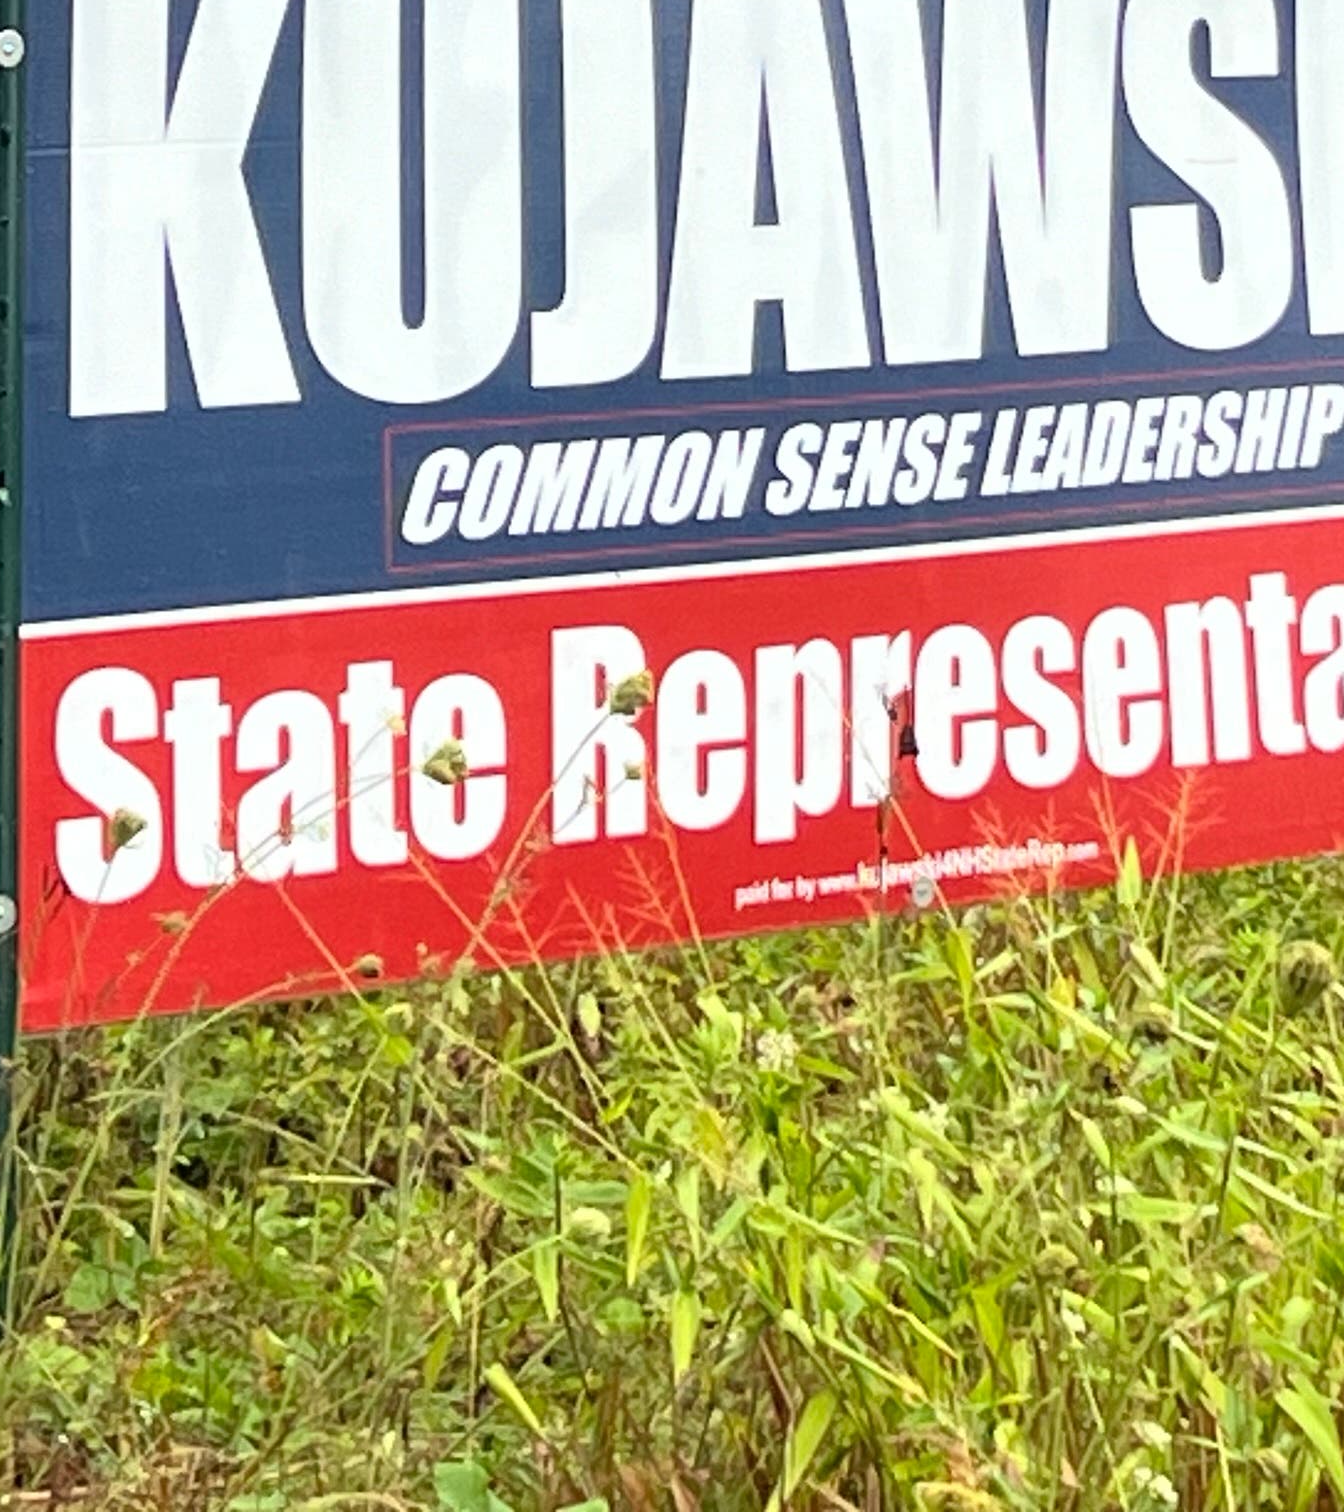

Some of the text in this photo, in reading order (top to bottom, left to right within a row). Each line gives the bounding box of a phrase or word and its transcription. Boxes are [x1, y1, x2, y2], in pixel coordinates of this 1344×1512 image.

[400, 426, 763, 545] COMMON
[763, 410, 980, 517] SENSE
[54, 660, 508, 905] State
[734, 879, 769, 912] paid
[770, 875, 794, 901] for
[794, 874, 817, 903] by
